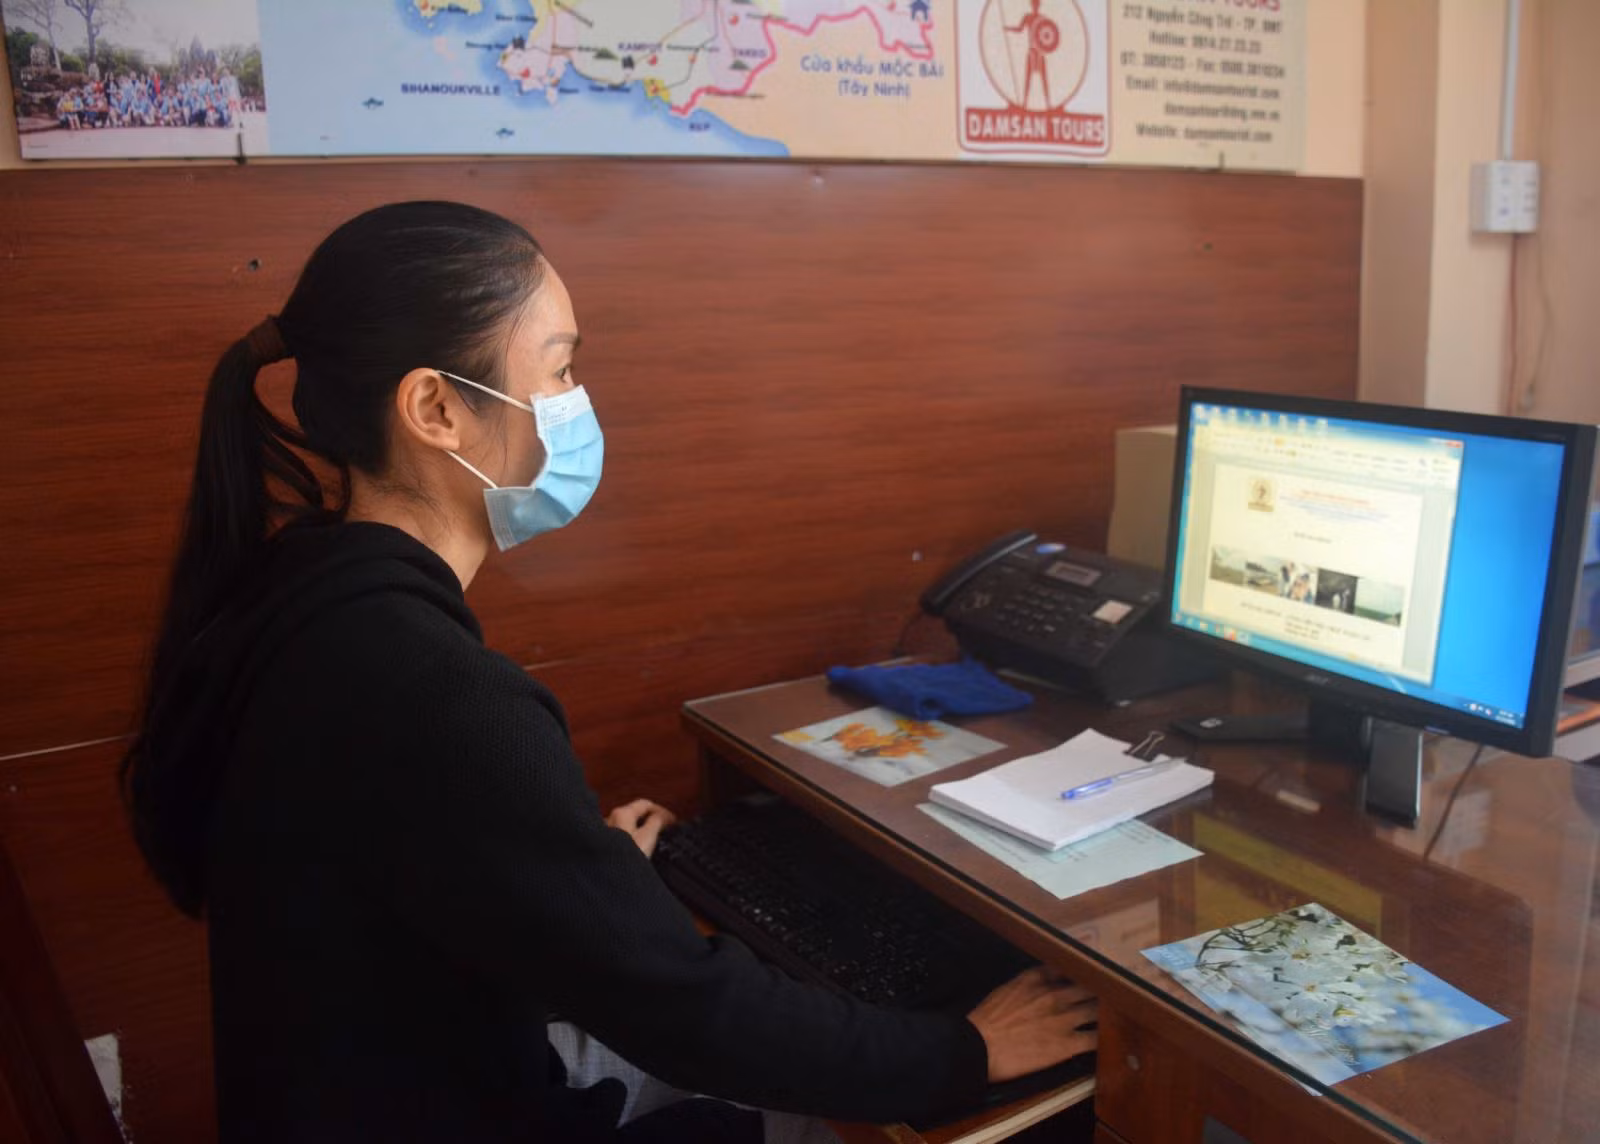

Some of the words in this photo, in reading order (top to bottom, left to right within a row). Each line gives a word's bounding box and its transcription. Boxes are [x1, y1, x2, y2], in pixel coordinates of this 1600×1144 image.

[400, 83, 500, 97] SIHANOUKVILLE
[968, 114, 1047, 139] DAMSAN
[1052, 117, 1104, 142] TOURS
